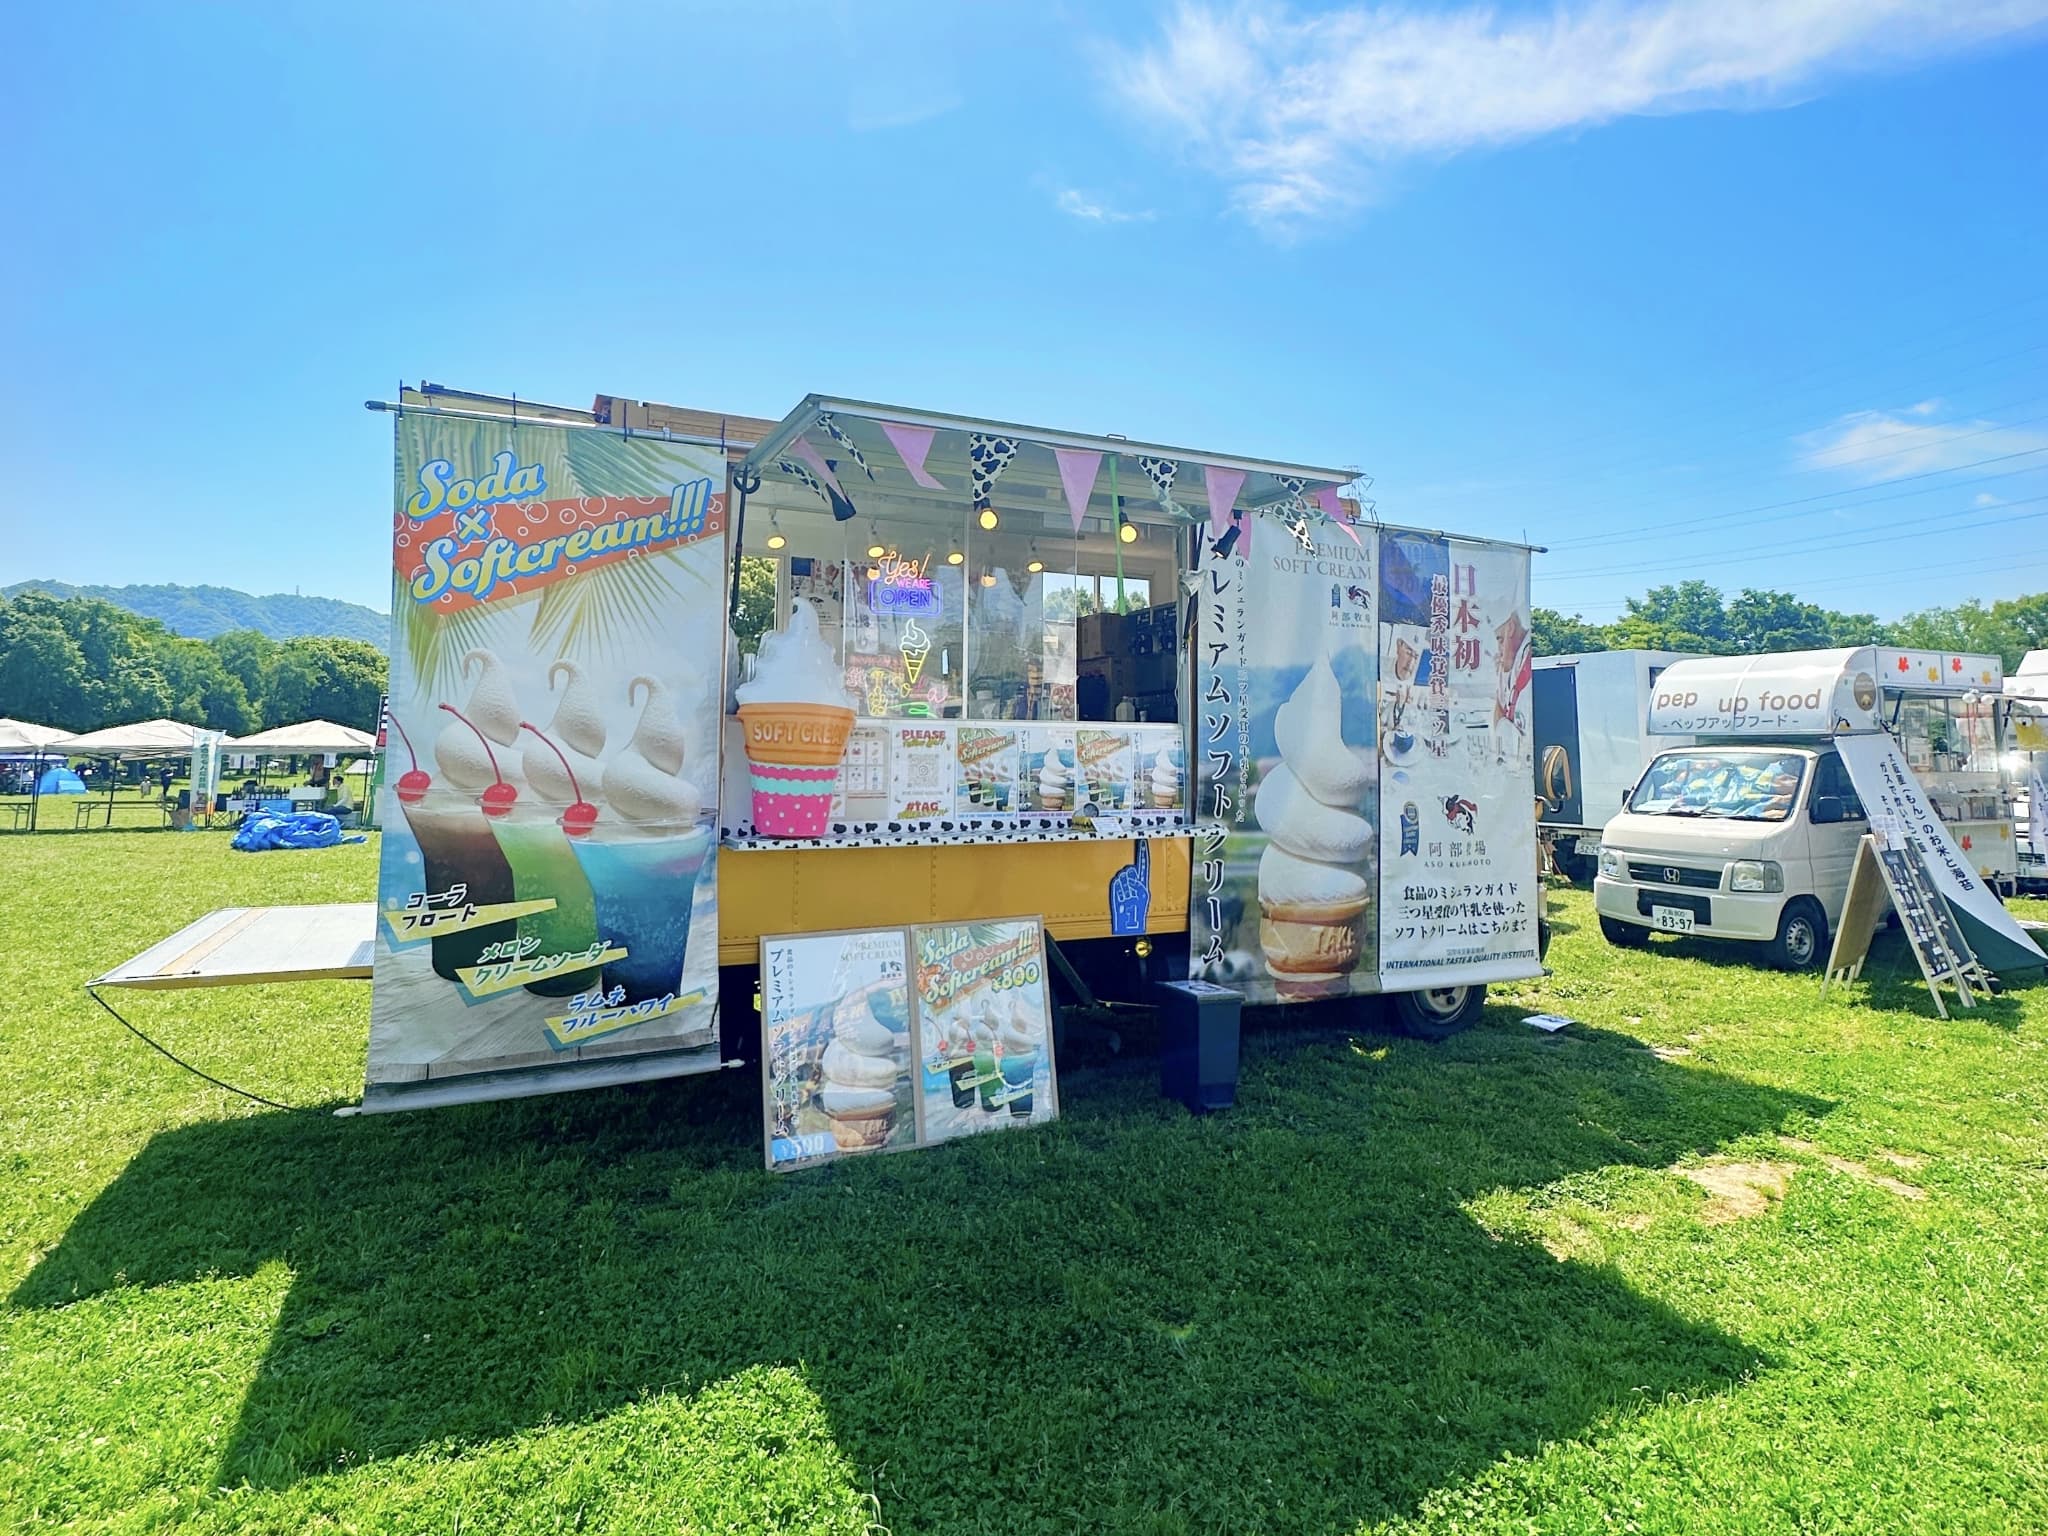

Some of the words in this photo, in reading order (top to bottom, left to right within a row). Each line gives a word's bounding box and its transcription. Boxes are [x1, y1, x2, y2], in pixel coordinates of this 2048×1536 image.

[408, 451, 547, 520] Soda
[411, 477, 712, 603] Softcream!!!
[1295, 541, 1371, 562] PEMIUM
[878, 550, 931, 585] Yes!
[1273, 556, 1312, 574] SOFT
[1316, 562, 1372, 580] CREAM
[880, 588, 932, 608] OPEN
[1452, 563, 1481, 672] 日本初
[1657, 692, 1698, 710] pep
[1718, 696, 1748, 713] up
[1759, 688, 1822, 711] food
[753, 719, 798, 743] SOFT
[902, 729, 946, 740] PLEASE
[406, 884, 468, 909] コーラ
[1404, 882, 1518, 901] 食品のミシュランガイド
[402, 903, 477, 930] フロート
[1662, 915, 1692, 930] 83-97
[477, 937, 542, 964] メロン
[922, 928, 970, 966] Soda
[474, 940, 612, 986] クリームソーダ
[925, 927, 1035, 1004] Softcream!!!
[1386, 957, 1444, 969] INTERNATIONAL
[1446, 955, 1467, 965] TASTE
[991, 961, 1039, 993] ¥800
[568, 985, 625, 1014] ラムネ
